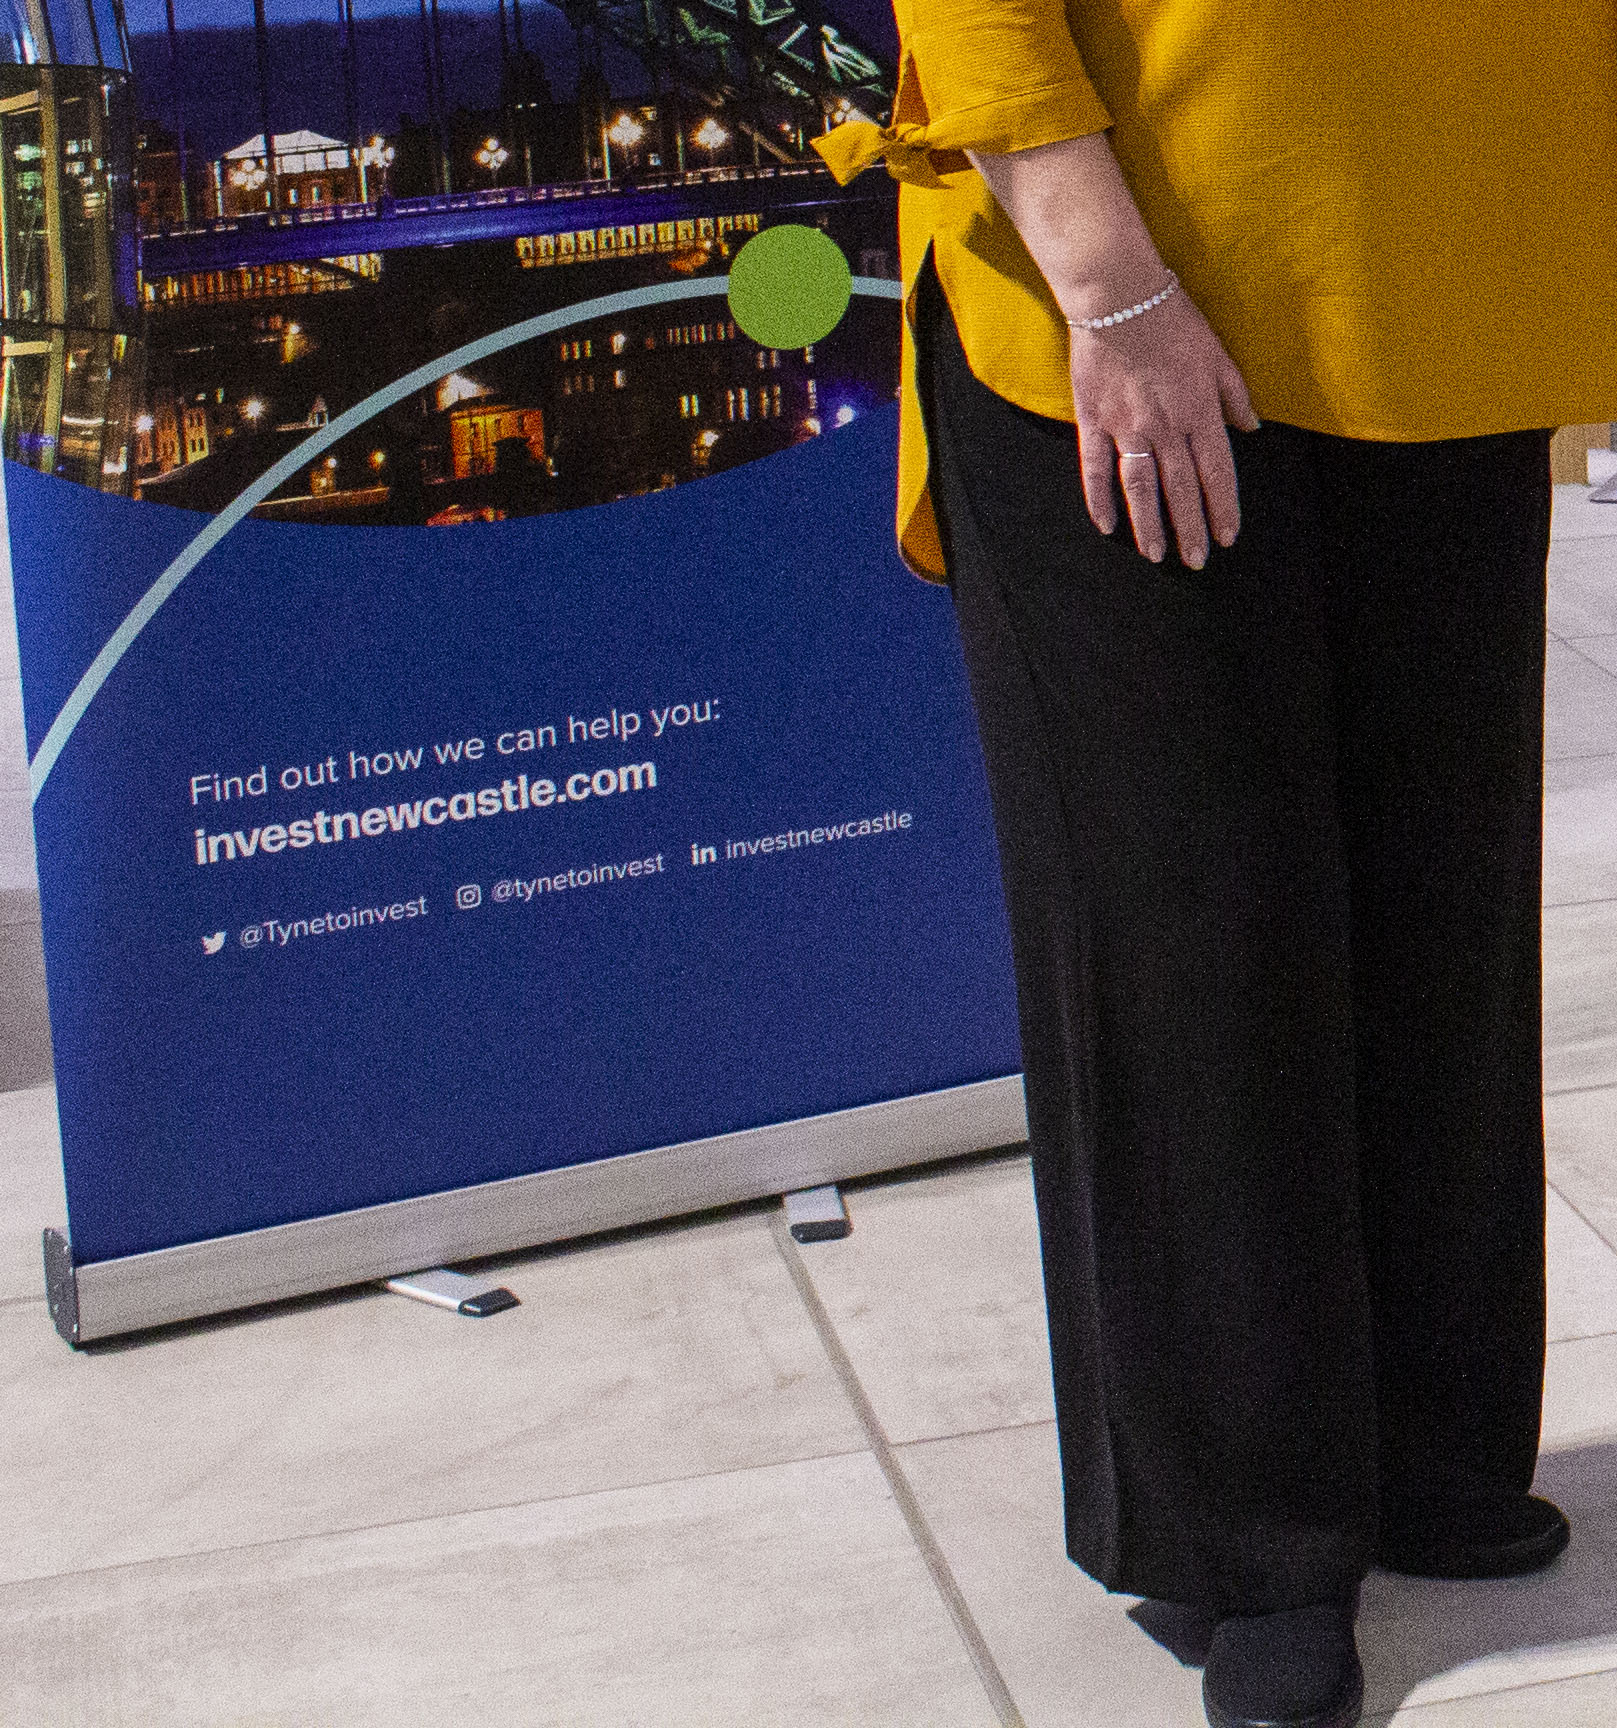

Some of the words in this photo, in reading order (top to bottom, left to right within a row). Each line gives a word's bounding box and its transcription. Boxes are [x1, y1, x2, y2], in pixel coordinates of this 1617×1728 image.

[189, 762, 270, 805] Find
[279, 754, 339, 792] out
[348, 745, 424, 780] how
[433, 736, 486, 766] we
[496, 723, 557, 756] can
[566, 707, 642, 744] help
[650, 696, 722, 738] you:
[193, 760, 658, 866] investnewcastle.com
[239, 896, 429, 950] @Tynetoinvest
[491, 854, 665, 905] @tynetoinvest
[725, 810, 913, 860] investnewcastle
